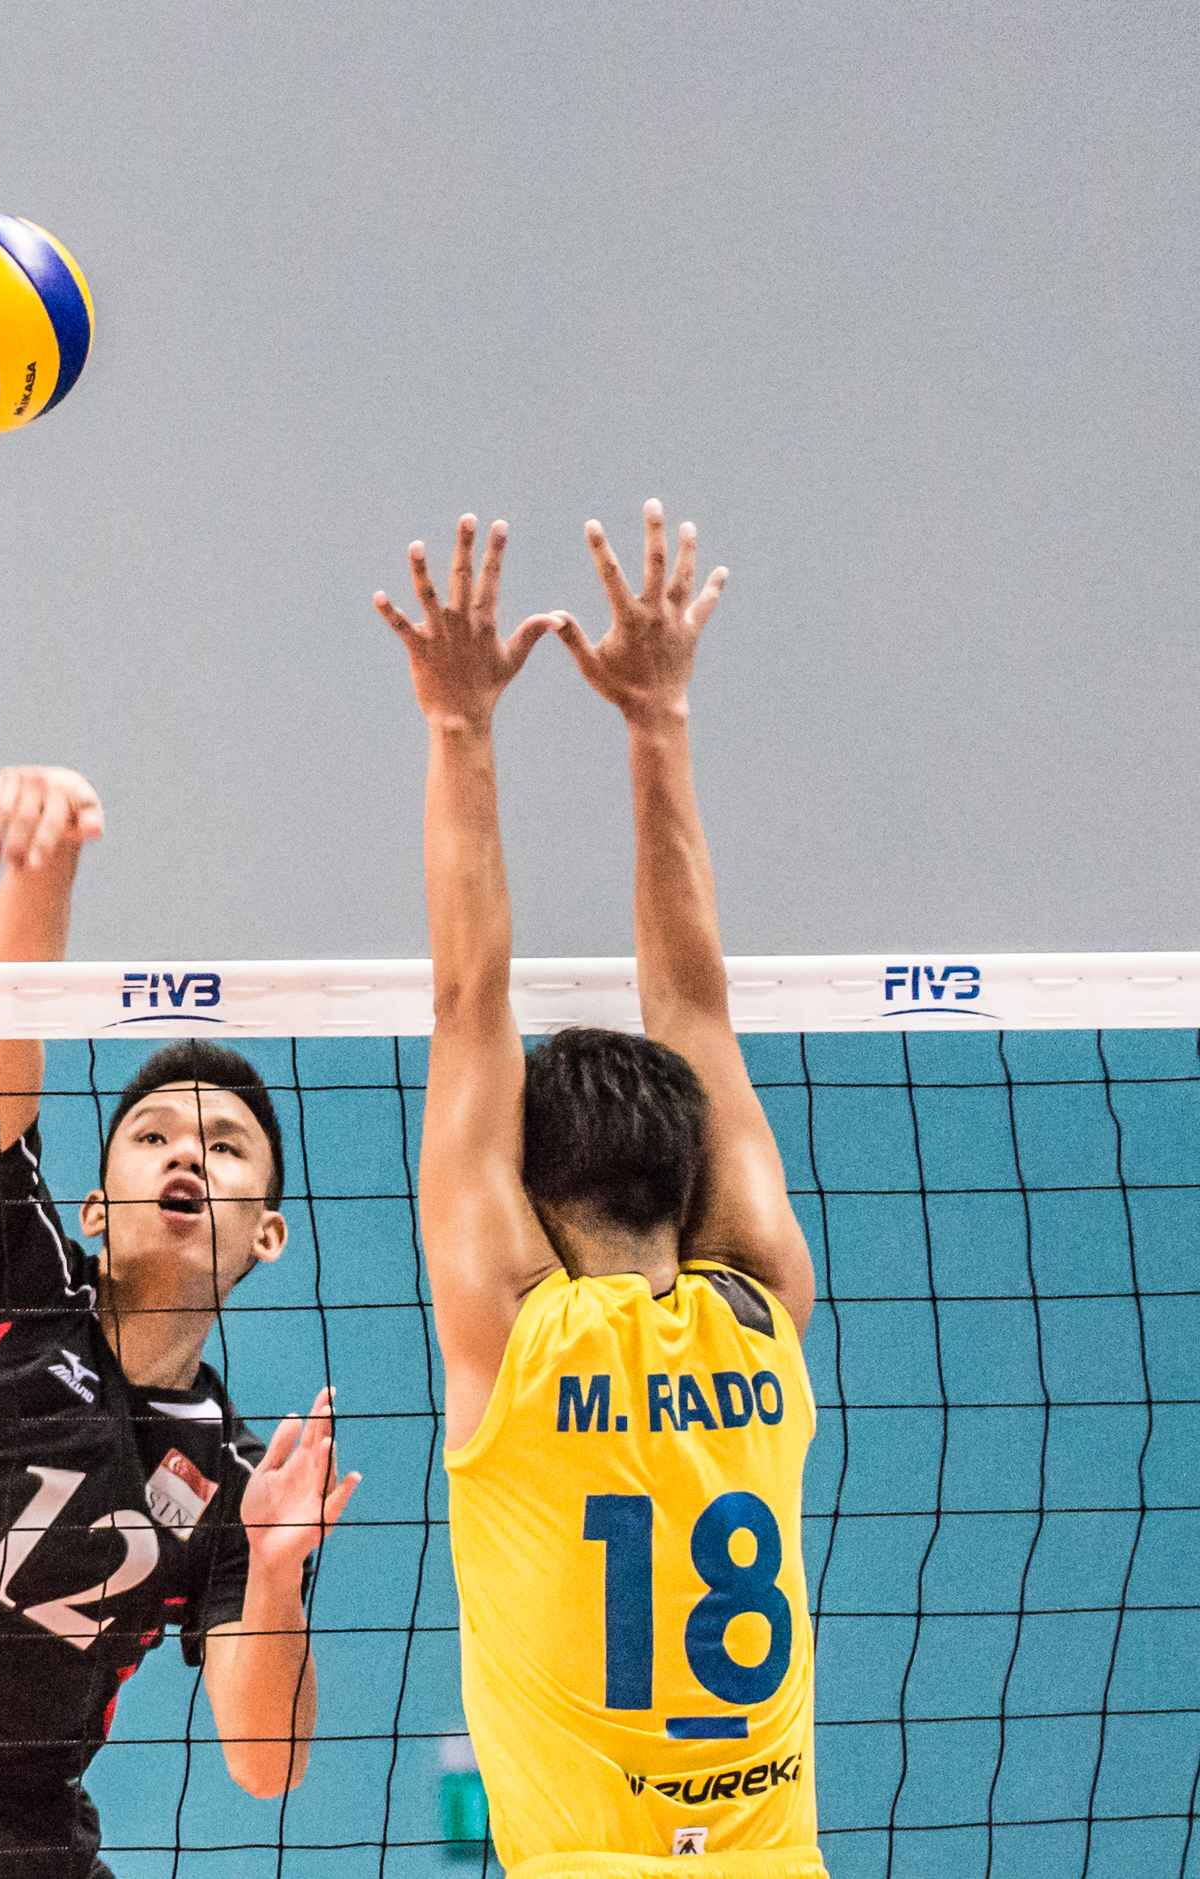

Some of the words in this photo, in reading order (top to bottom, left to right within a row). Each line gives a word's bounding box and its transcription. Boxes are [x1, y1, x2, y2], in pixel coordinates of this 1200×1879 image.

[13, 361, 37, 416] MIKASA
[122, 973, 221, 1008] FIVB
[884, 966, 981, 1001] FIVB
[556, 1374, 629, 1432] M.
[647, 1370, 784, 1432] RADO
[149, 1491, 191, 1528] SIN
[583, 1491, 792, 1711] 18
